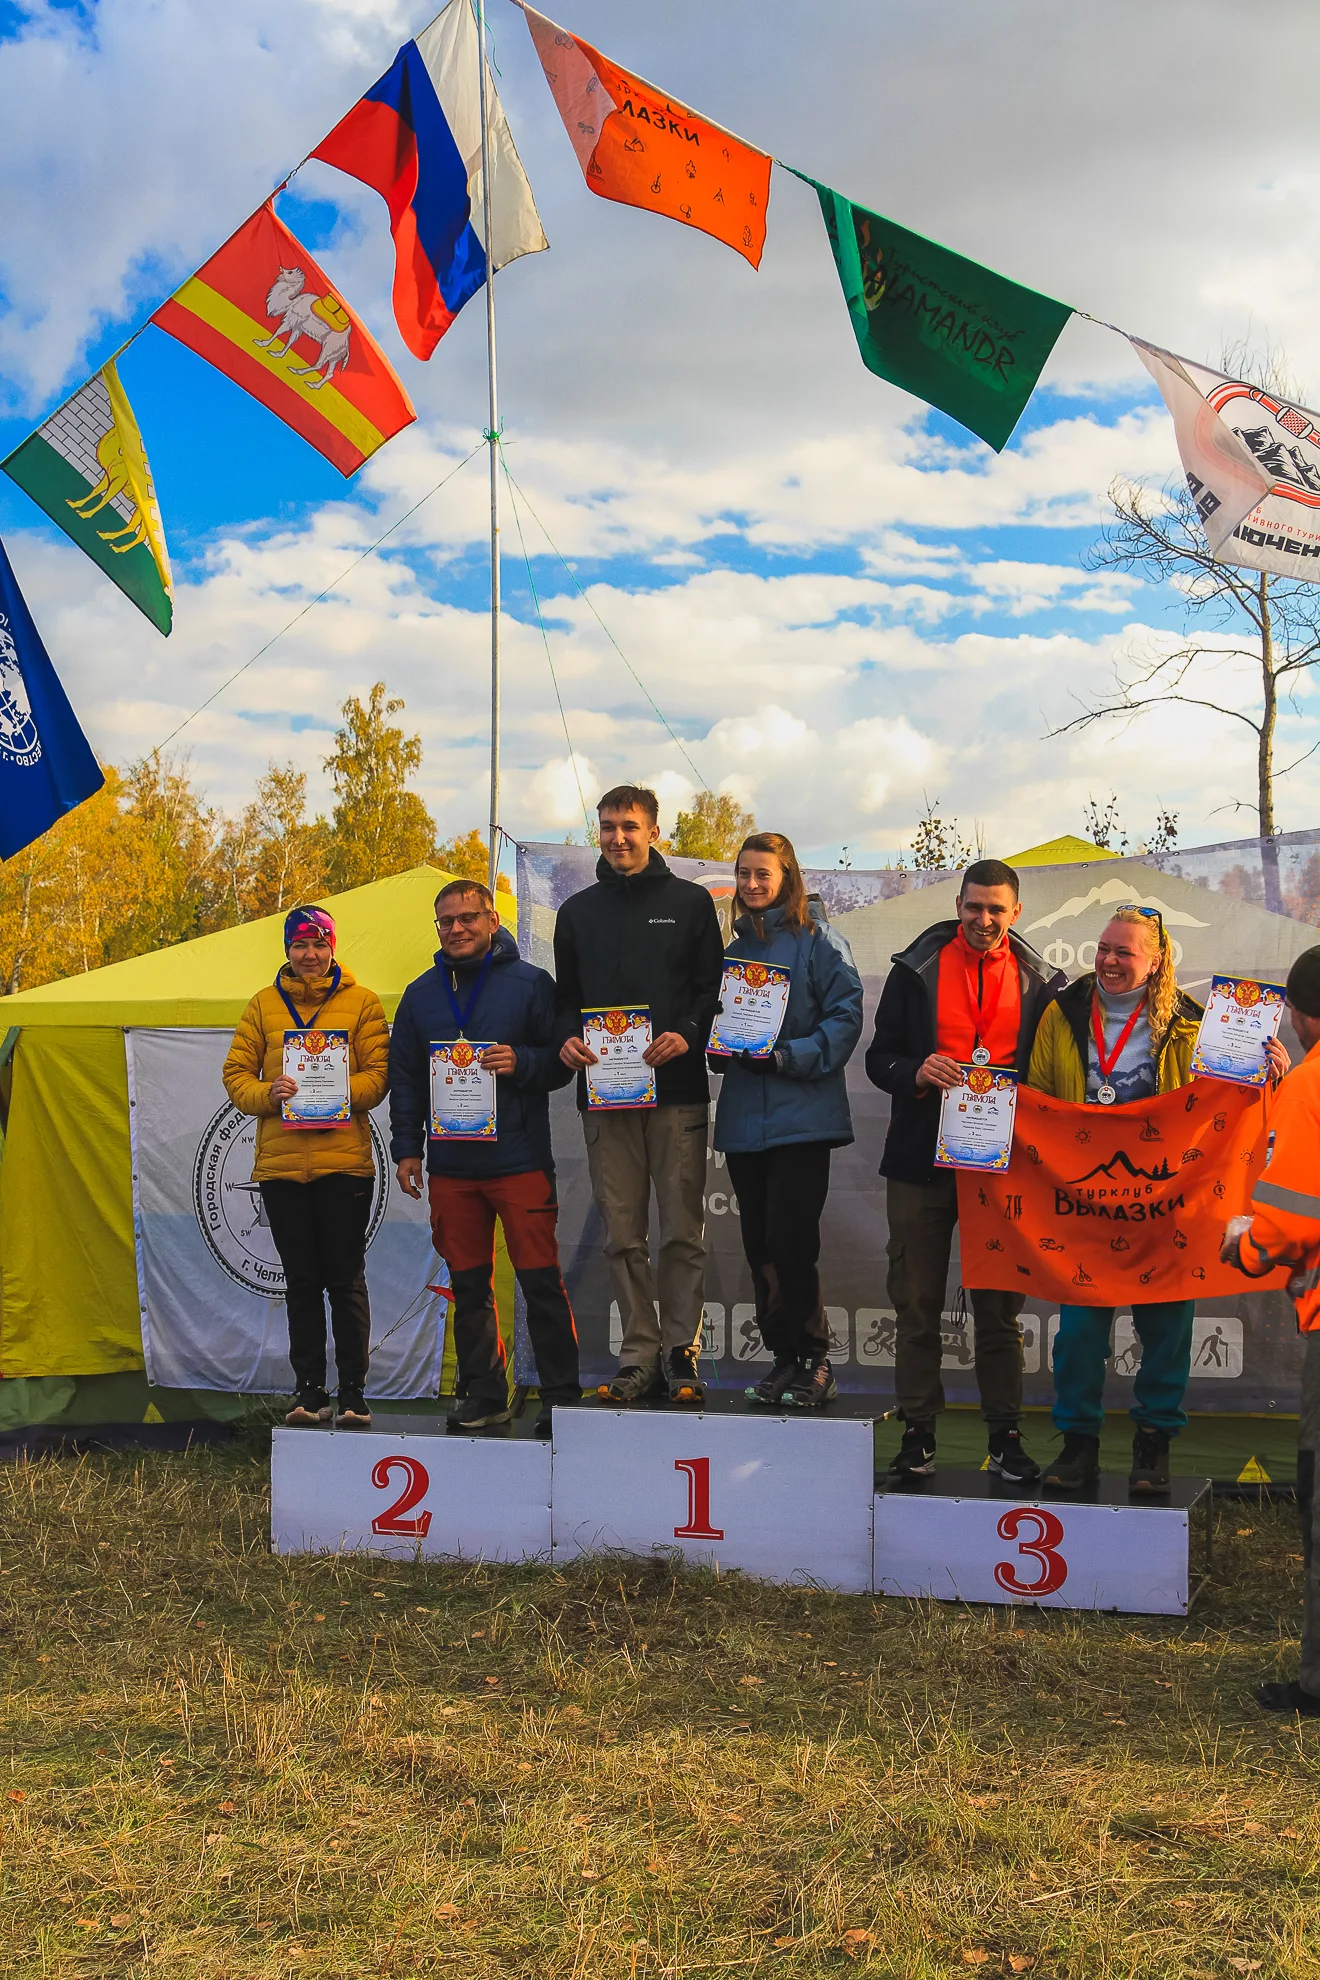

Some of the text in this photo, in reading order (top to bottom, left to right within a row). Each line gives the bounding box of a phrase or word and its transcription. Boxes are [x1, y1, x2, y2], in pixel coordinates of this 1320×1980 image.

[619, 99, 700, 147] ЛАЗКИ
[863, 264, 1015, 384] ALAMANDR
[1246, 514, 1320, 541] ТИВНОГО ТУРИ
[738, 986, 771, 998] ГРАМОТА
[1226, 1005, 1261, 1018] ГРАМОТА
[602, 1035, 634, 1044] ГРАМОТА
[300, 1055, 331, 1063] ГРАМОТА
[447, 1068, 478, 1076] ГРАМОТА
[962, 1092, 997, 1105] ГРАМОТА
[220, 1110, 246, 1142] фед
[205, 1144, 223, 1231] Городская
[1076, 1183, 1153, 1200] турклуб
[240, 1229, 252, 1237] SW
[254, 1261, 287, 1283] Челя
[370, 1455, 433, 1539] 2
[673, 1457, 725, 1541] 1
[993, 1506, 1069, 1597] 3
